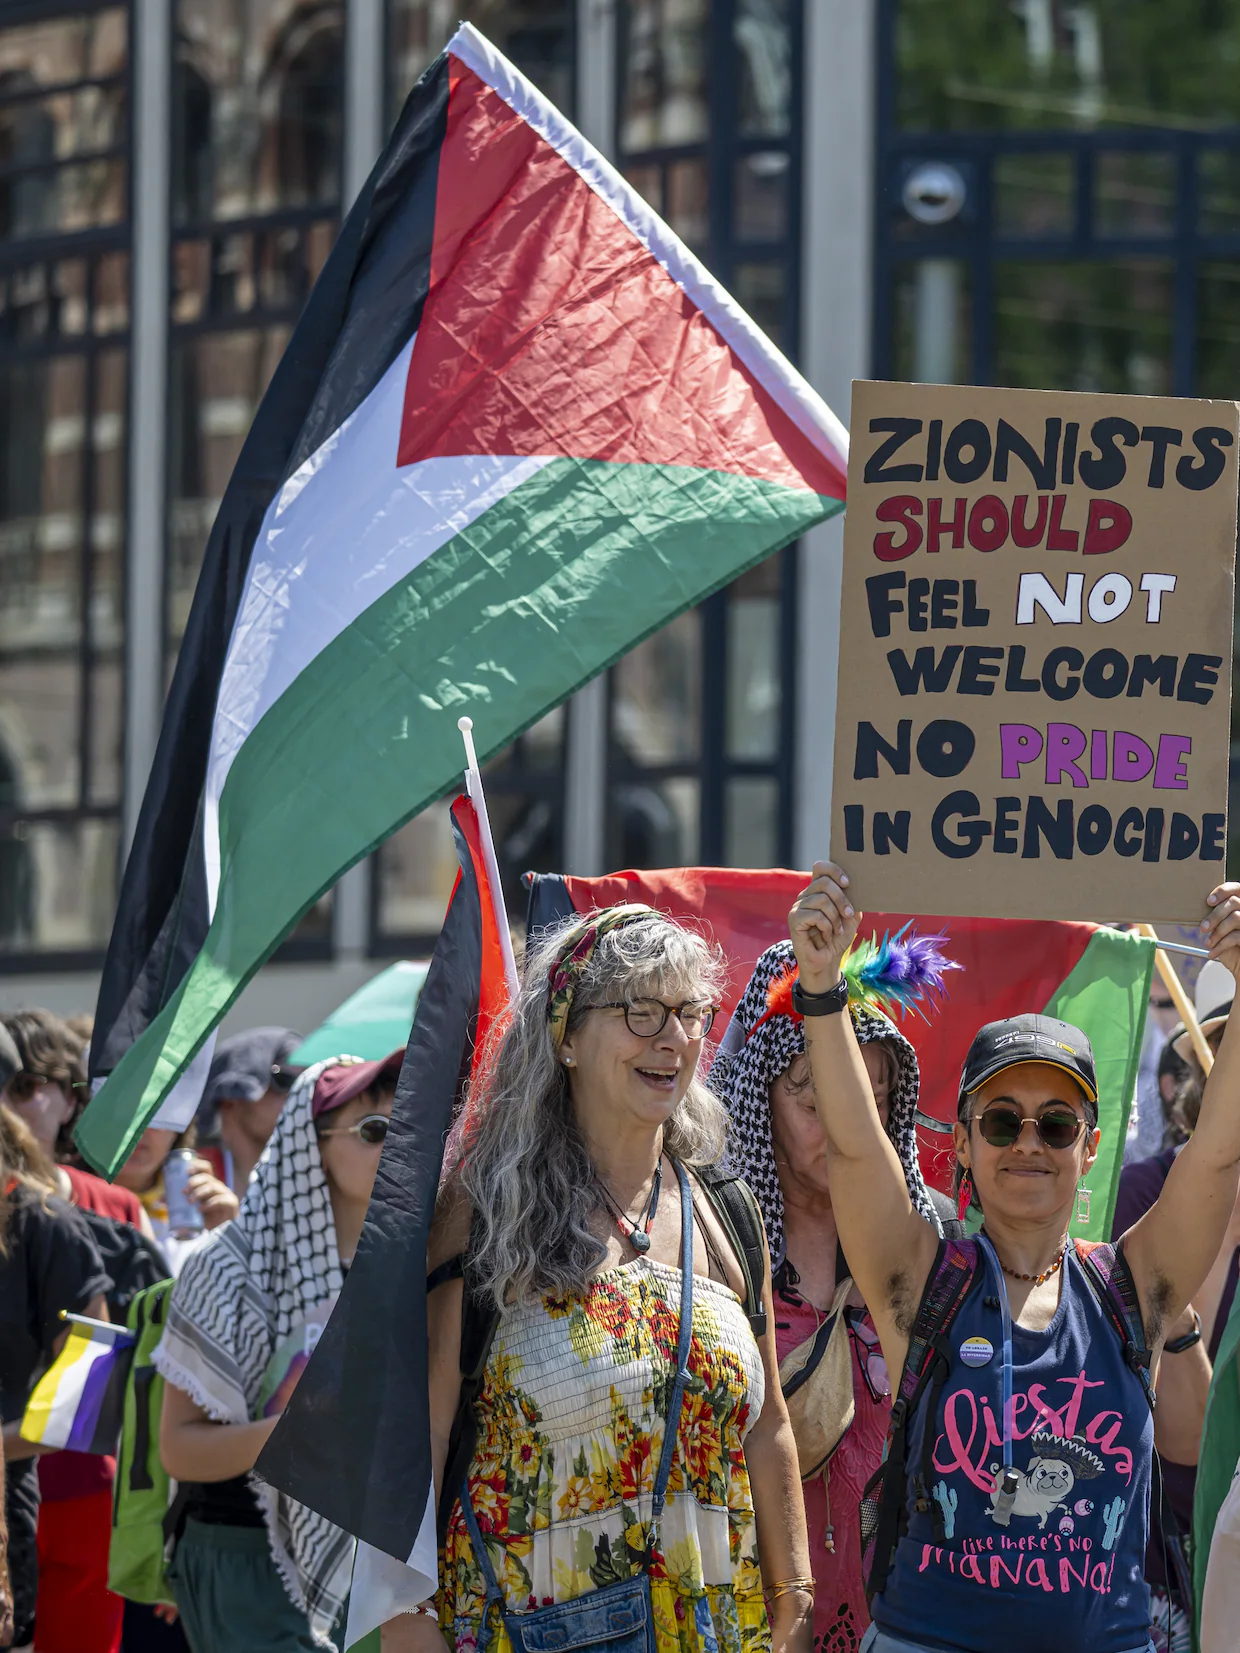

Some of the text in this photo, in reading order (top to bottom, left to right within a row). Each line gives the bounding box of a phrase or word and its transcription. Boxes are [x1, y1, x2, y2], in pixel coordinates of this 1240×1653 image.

[864, 418, 1233, 491] ZIONISTS
[873, 495, 1133, 561] SHOULD
[866, 571, 1178, 637] FEEL NOT
[887, 645, 1223, 704] WELCOME
[854, 720, 1192, 790] NO PRIDE
[844, 790, 1225, 862] IN GENOCIDE
